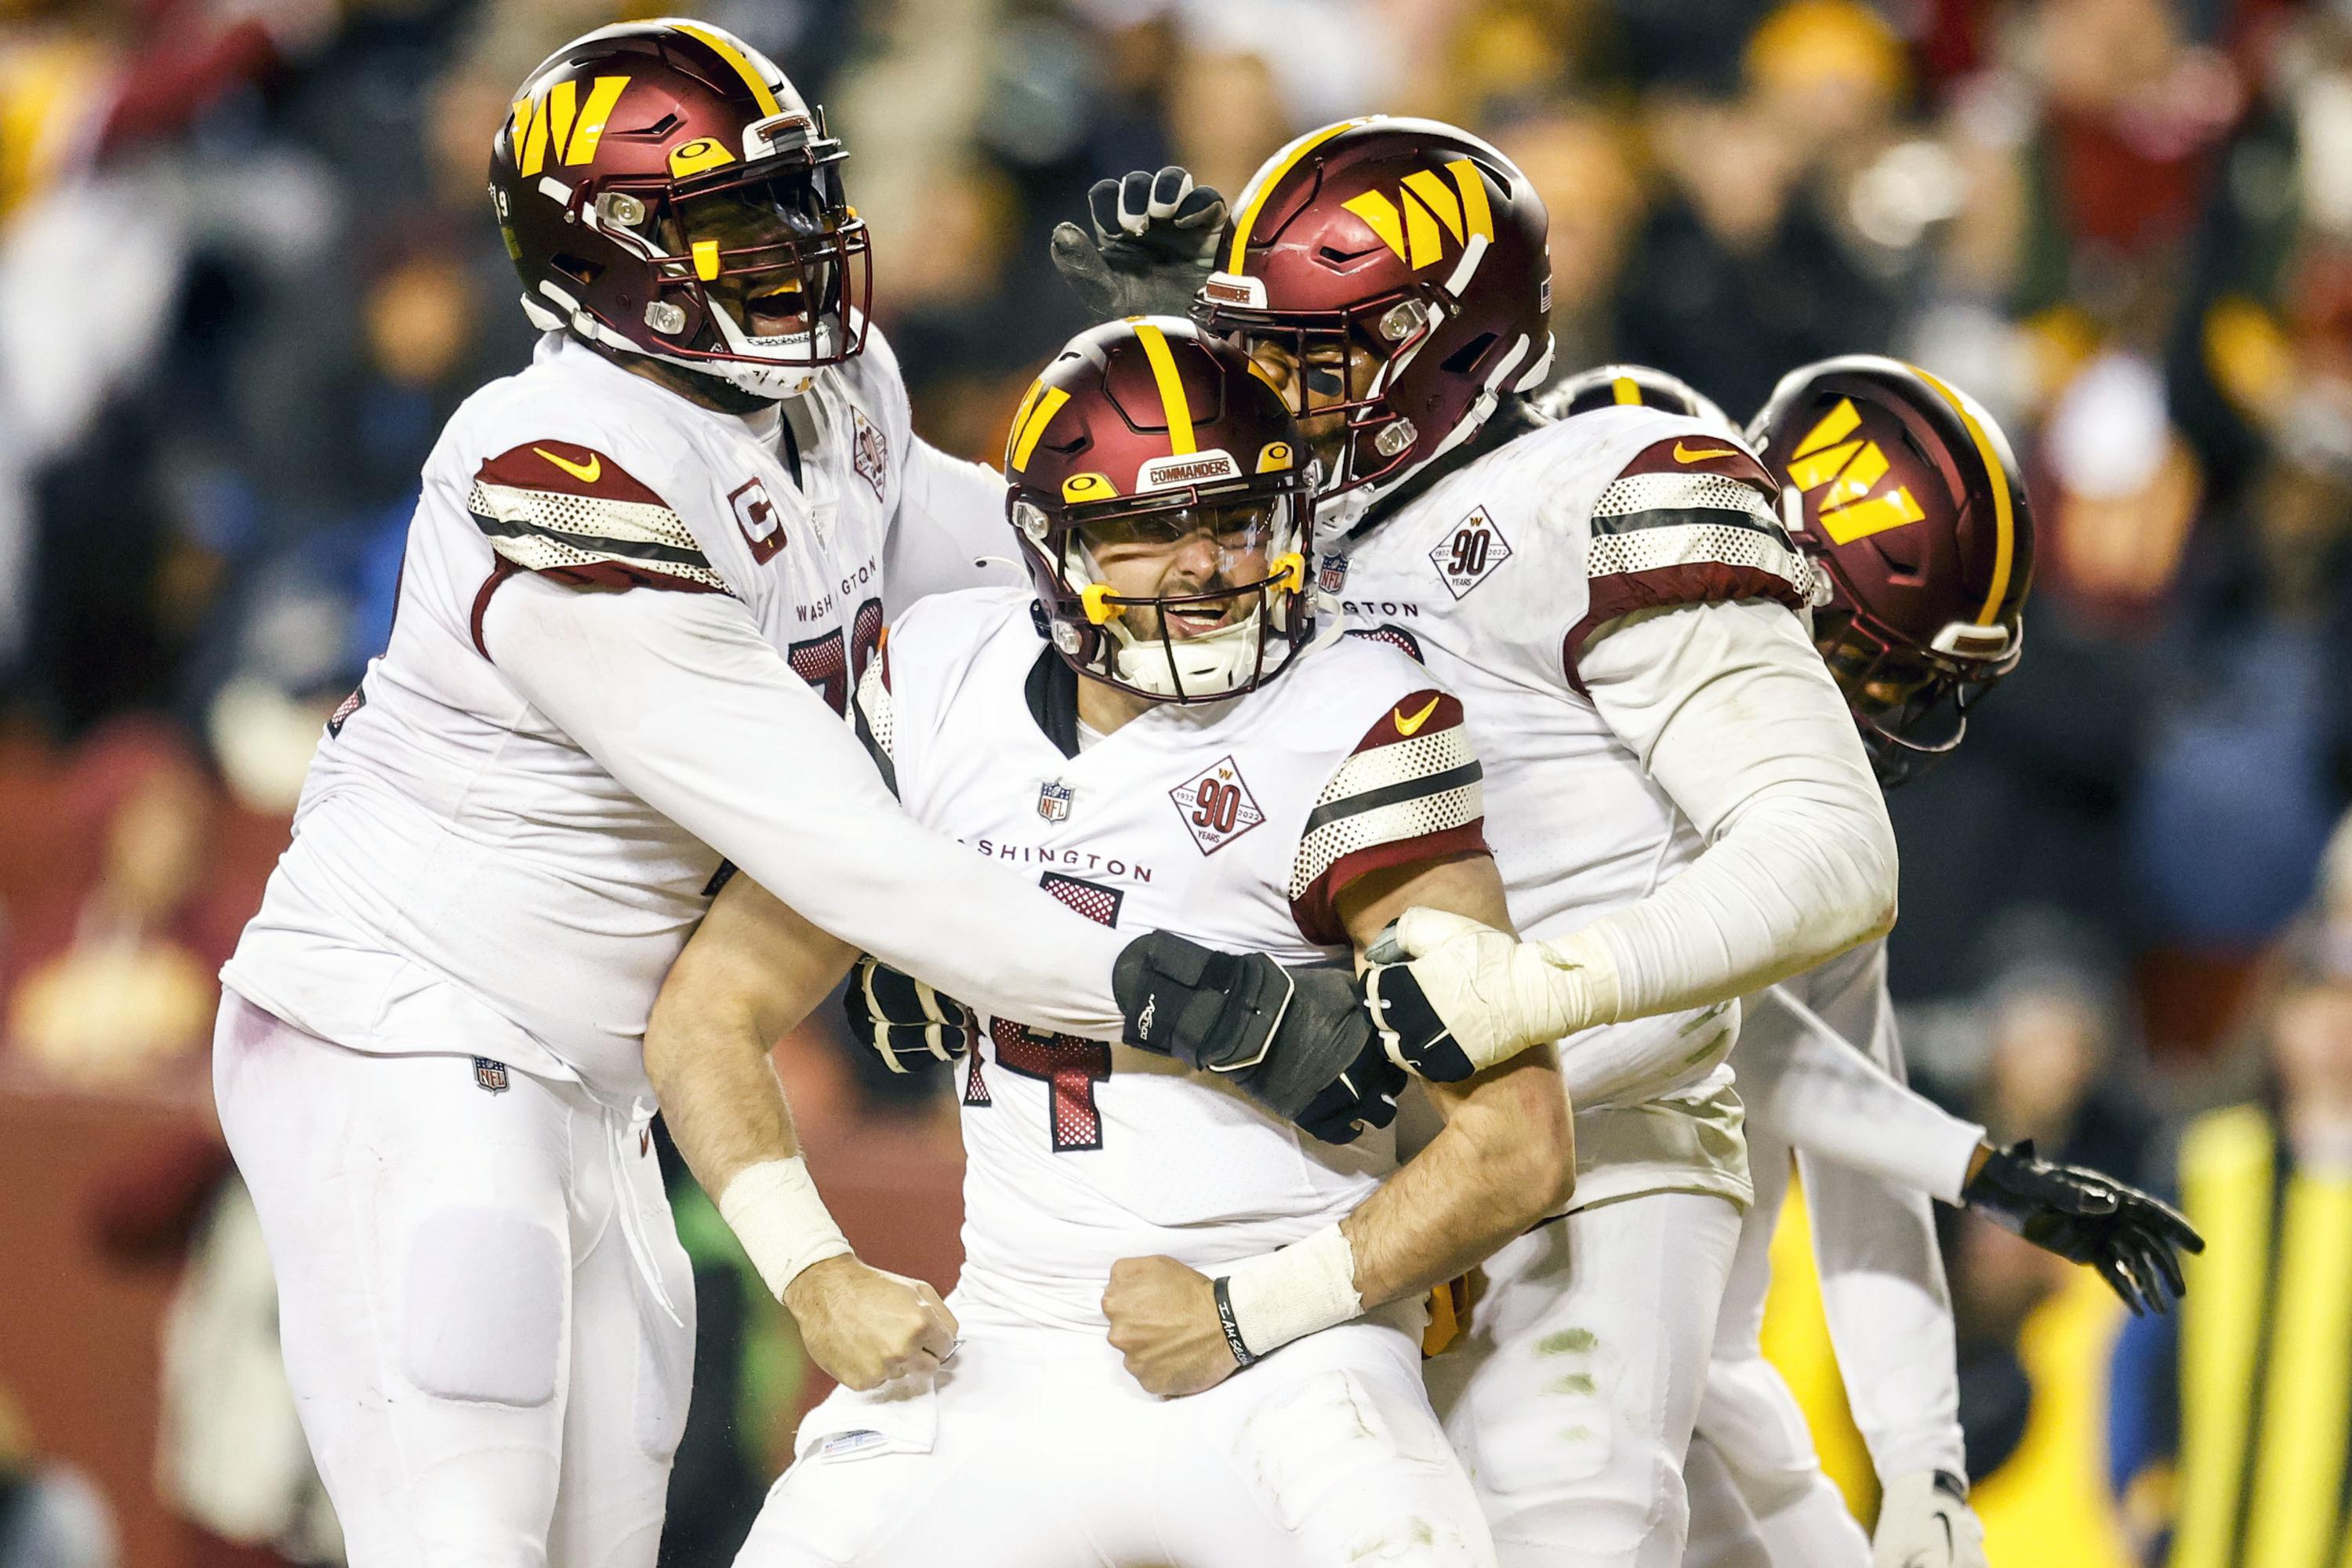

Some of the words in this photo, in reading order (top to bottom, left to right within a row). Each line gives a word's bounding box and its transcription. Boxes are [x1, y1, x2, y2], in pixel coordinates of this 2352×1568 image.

[1149, 459, 1231, 483] COMMANDERS
[734, 484, 779, 543] C
[1447, 529, 1490, 575] 90
[1320, 569, 1341, 590] NFL
[1452, 578, 1472, 586] YEARS
[1341, 601, 1418, 617] GTON
[1040, 797, 1065, 818] NFL
[1177, 792, 1194, 802] 1932
[1192, 779, 1241, 833] 90
[1238, 810, 1259, 820] 2022
[1197, 830, 1221, 844] YEARS
[956, 838, 1152, 883] SHINGTON
[480, 1069, 506, 1087] NFL
[1218, 1301, 1230, 1319] I
[1222, 1320, 1236, 1338] AM
